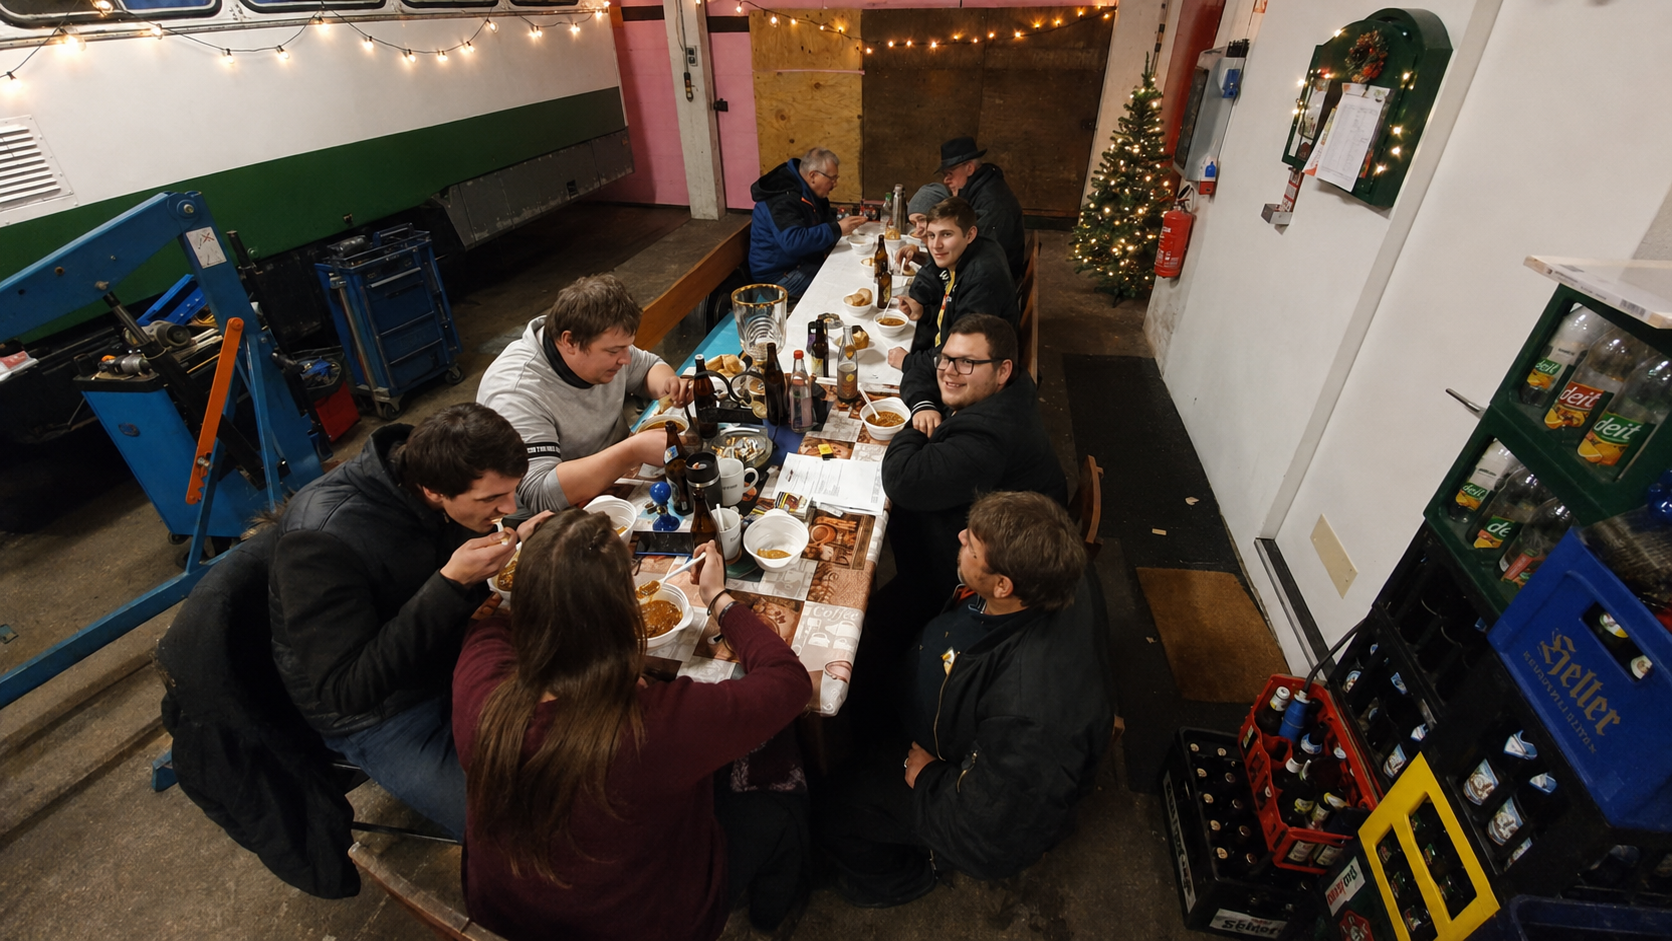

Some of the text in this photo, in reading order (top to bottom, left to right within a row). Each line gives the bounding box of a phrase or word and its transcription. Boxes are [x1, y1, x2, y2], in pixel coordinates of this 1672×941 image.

[1559, 386, 1603, 408] deit
[1593, 417, 1642, 440] deit
[813, 605, 859, 622] Coffee
